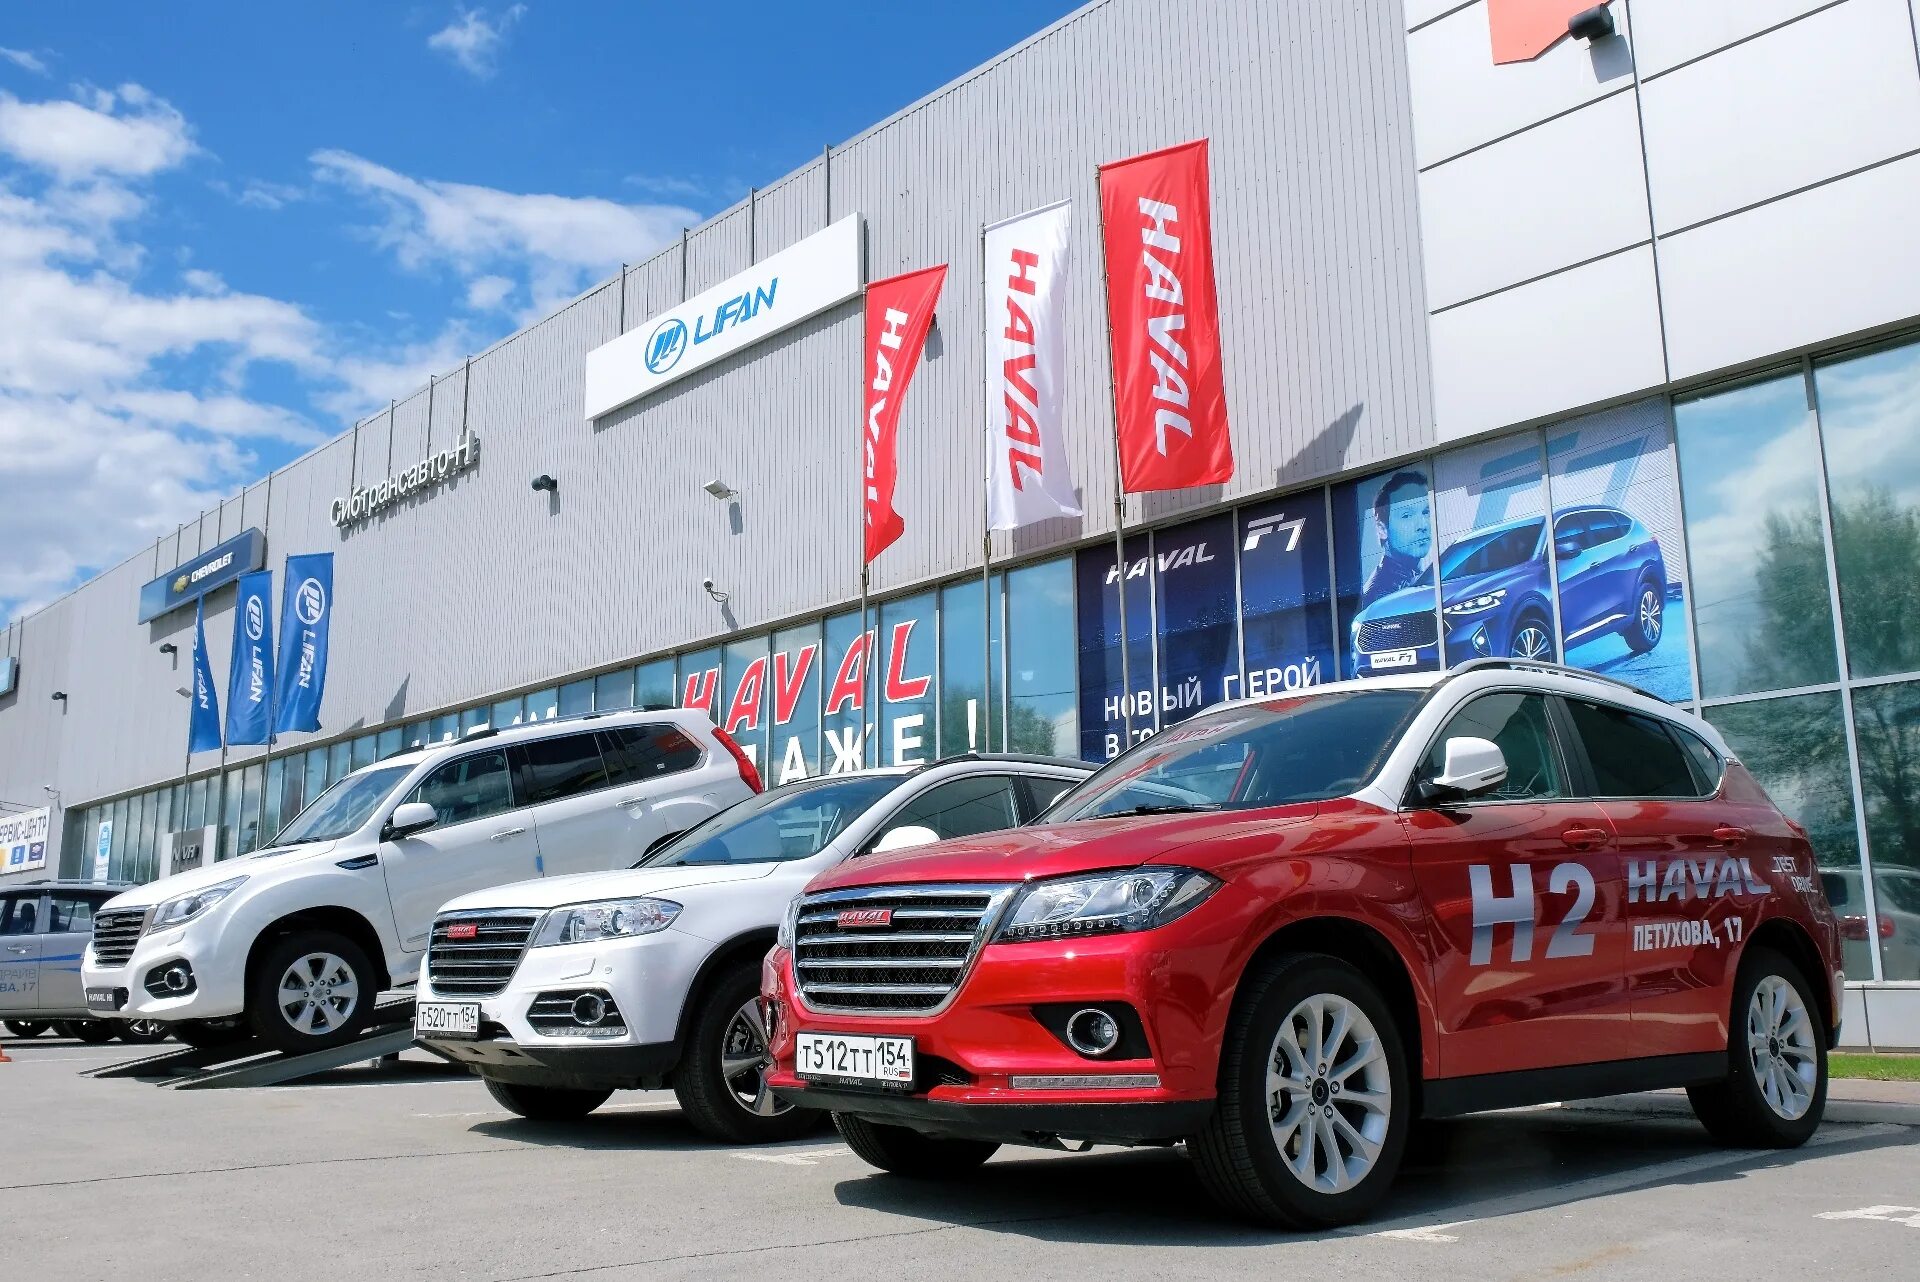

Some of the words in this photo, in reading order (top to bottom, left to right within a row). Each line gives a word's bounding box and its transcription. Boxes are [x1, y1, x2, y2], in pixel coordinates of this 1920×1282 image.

[693, 277, 778, 346] LIFAN
[1138, 197, 1193, 457] HAVAL
[1003, 248, 1043, 492] HAVAL
[330, 430, 476, 528] Сибтрансавто-Н
[191, 552, 234, 582] CHEVROLET
[1105, 542, 1216, 585] HAVAL
[1243, 512, 1307, 552] F7
[249, 646, 264, 703] LIFAN
[299, 630, 316, 689] LIFAN
[682, 619, 932, 735] HAVAL
[1104, 676, 1202, 722] НОВЫЙ
[1223, 655, 1321, 702] ГЕРОЙ
[1628, 857, 1772, 903] HAVAL
[838, 910, 889, 925] HAVAL
[1468, 862, 1596, 966] H2
[1633, 917, 1720, 952] ПЕТУХОВА,
[1724, 916, 1743, 943] 17
[460, 1006, 475, 1024] 154
[876, 1041, 907, 1067] 154
[883, 1066, 899, 1077] RUS
